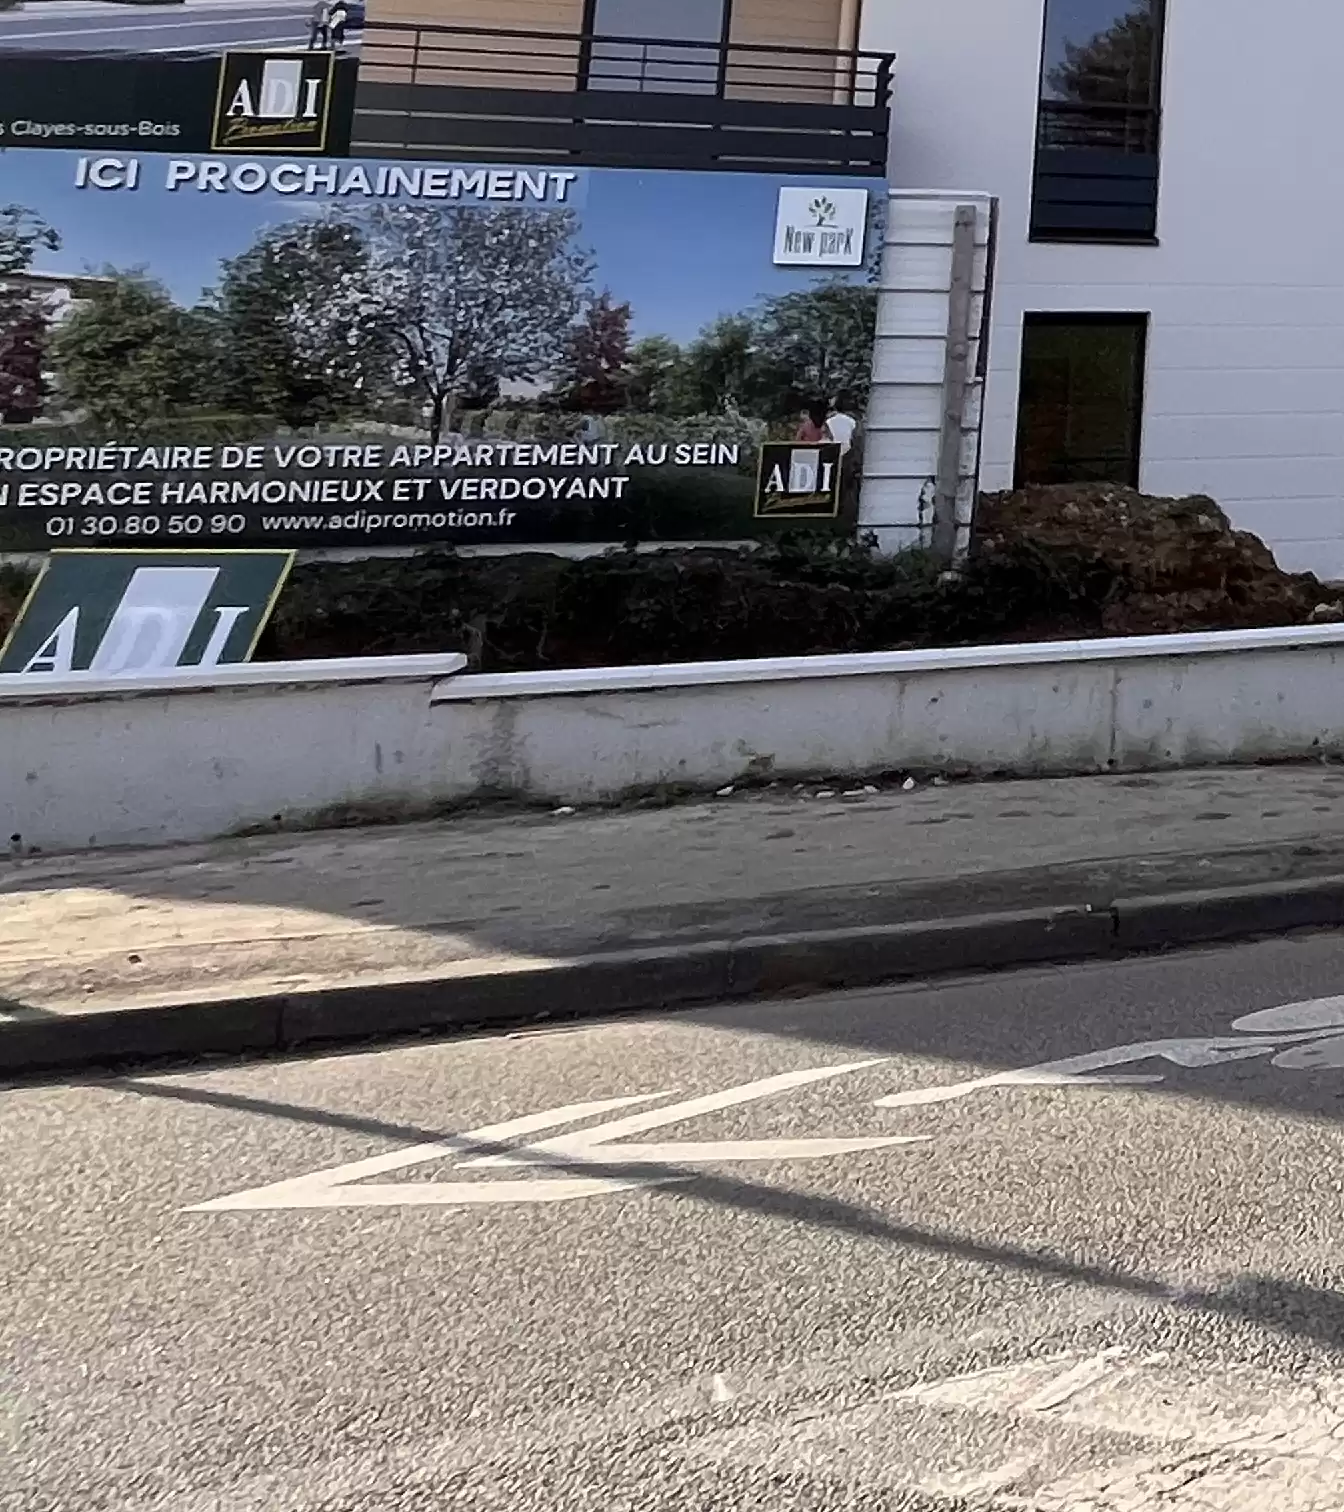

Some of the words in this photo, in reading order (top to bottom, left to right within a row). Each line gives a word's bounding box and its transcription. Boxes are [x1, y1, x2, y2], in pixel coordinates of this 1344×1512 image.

[226, 78, 322, 118] ADI
[10, 120, 181, 138] Clayes-sous-Bois
[75, 157, 140, 189] ICI
[166, 159, 577, 201] PROCHAINEMENT
[783, 224, 816, 254] New
[220, 446, 265, 469] DE
[274, 445, 383, 468] VOTRE
[388, 444, 618, 467] APPARTEMENT
[624, 444, 667, 466] AU
[674, 444, 739, 465] SEIN
[17, 482, 153, 506] ESPACE
[160, 479, 384, 505] HARMONIEUX
[392, 478, 432, 502] ET
[439, 477, 630, 501] VERDOYANT
[764, 462, 834, 493] ADI
[46, 516, 74, 536] 01
[80, 515, 118, 536] 30
[124, 515, 161, 535] 80
[167, 514, 203, 534] 50
[210, 514, 246, 533] 90
[262, 507, 517, 533] www.adipromotion.fr
